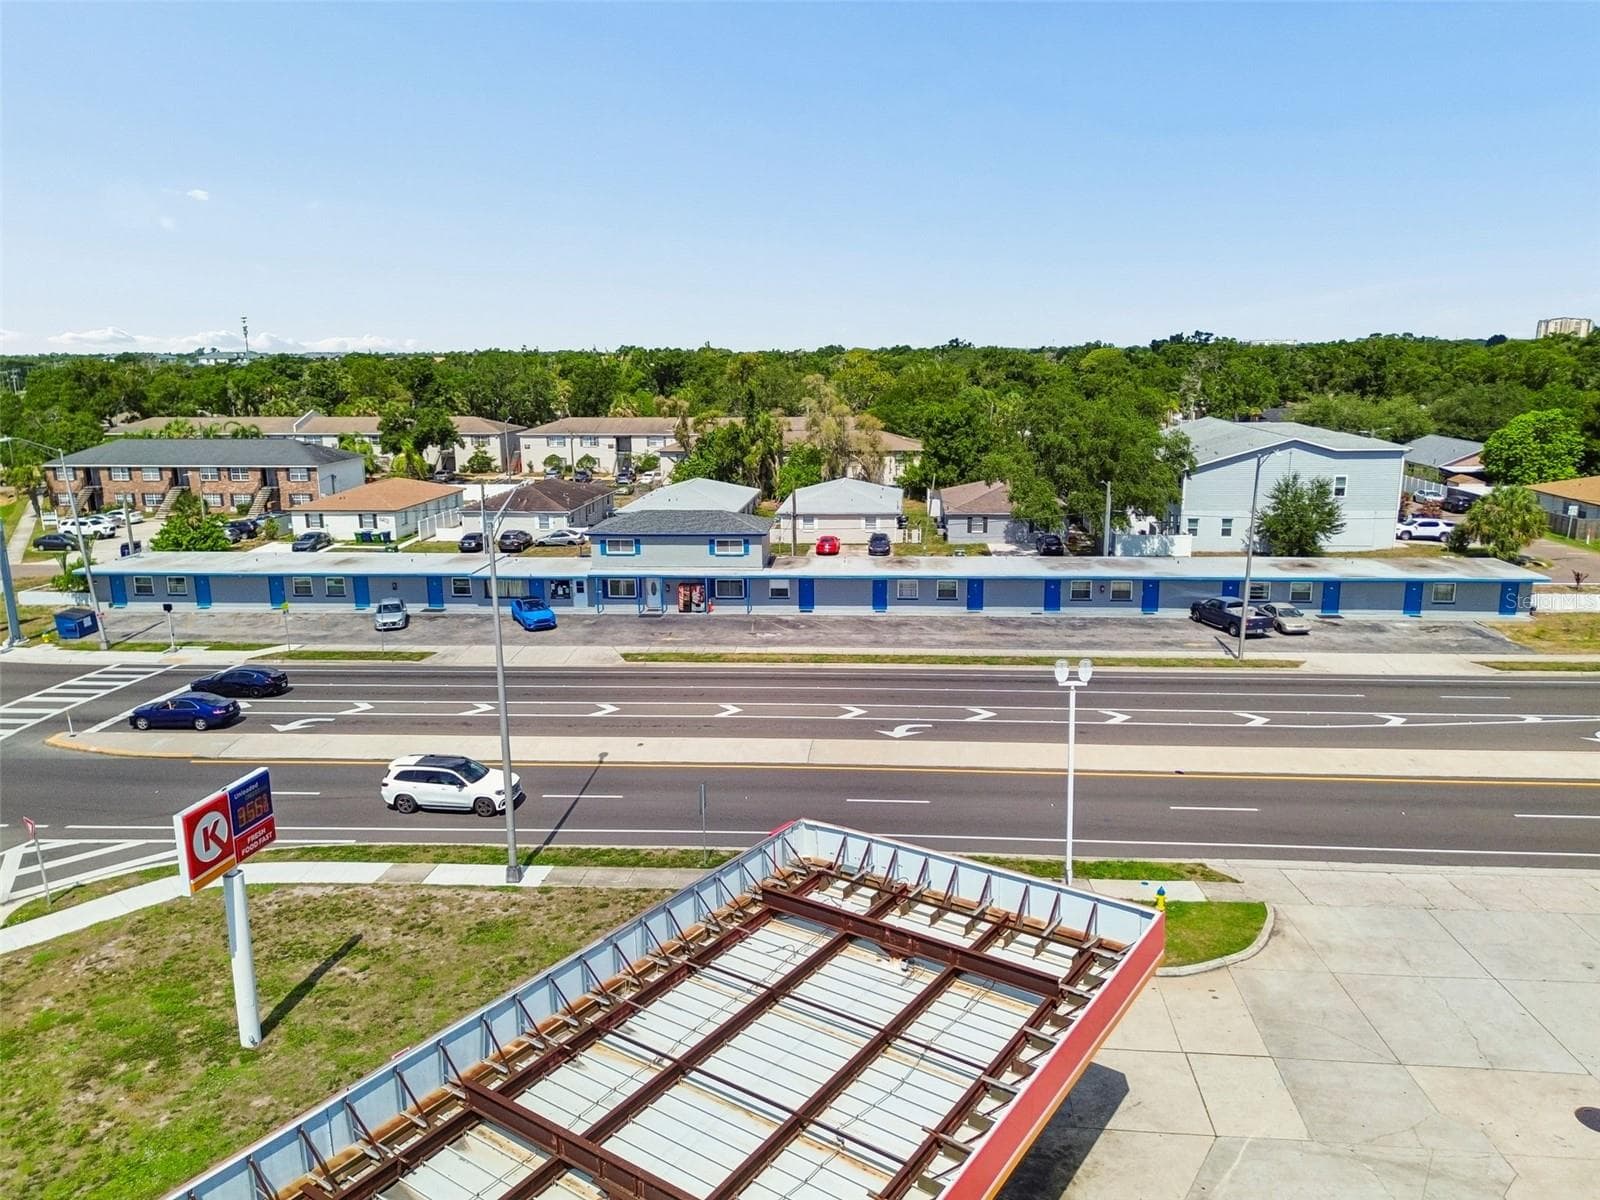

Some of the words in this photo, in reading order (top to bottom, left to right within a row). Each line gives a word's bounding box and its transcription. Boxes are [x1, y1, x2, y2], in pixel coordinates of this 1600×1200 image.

[241, 842, 259, 856] FOOD
[257, 832, 273, 845] FAST
[247, 828, 266, 844] FRESH
